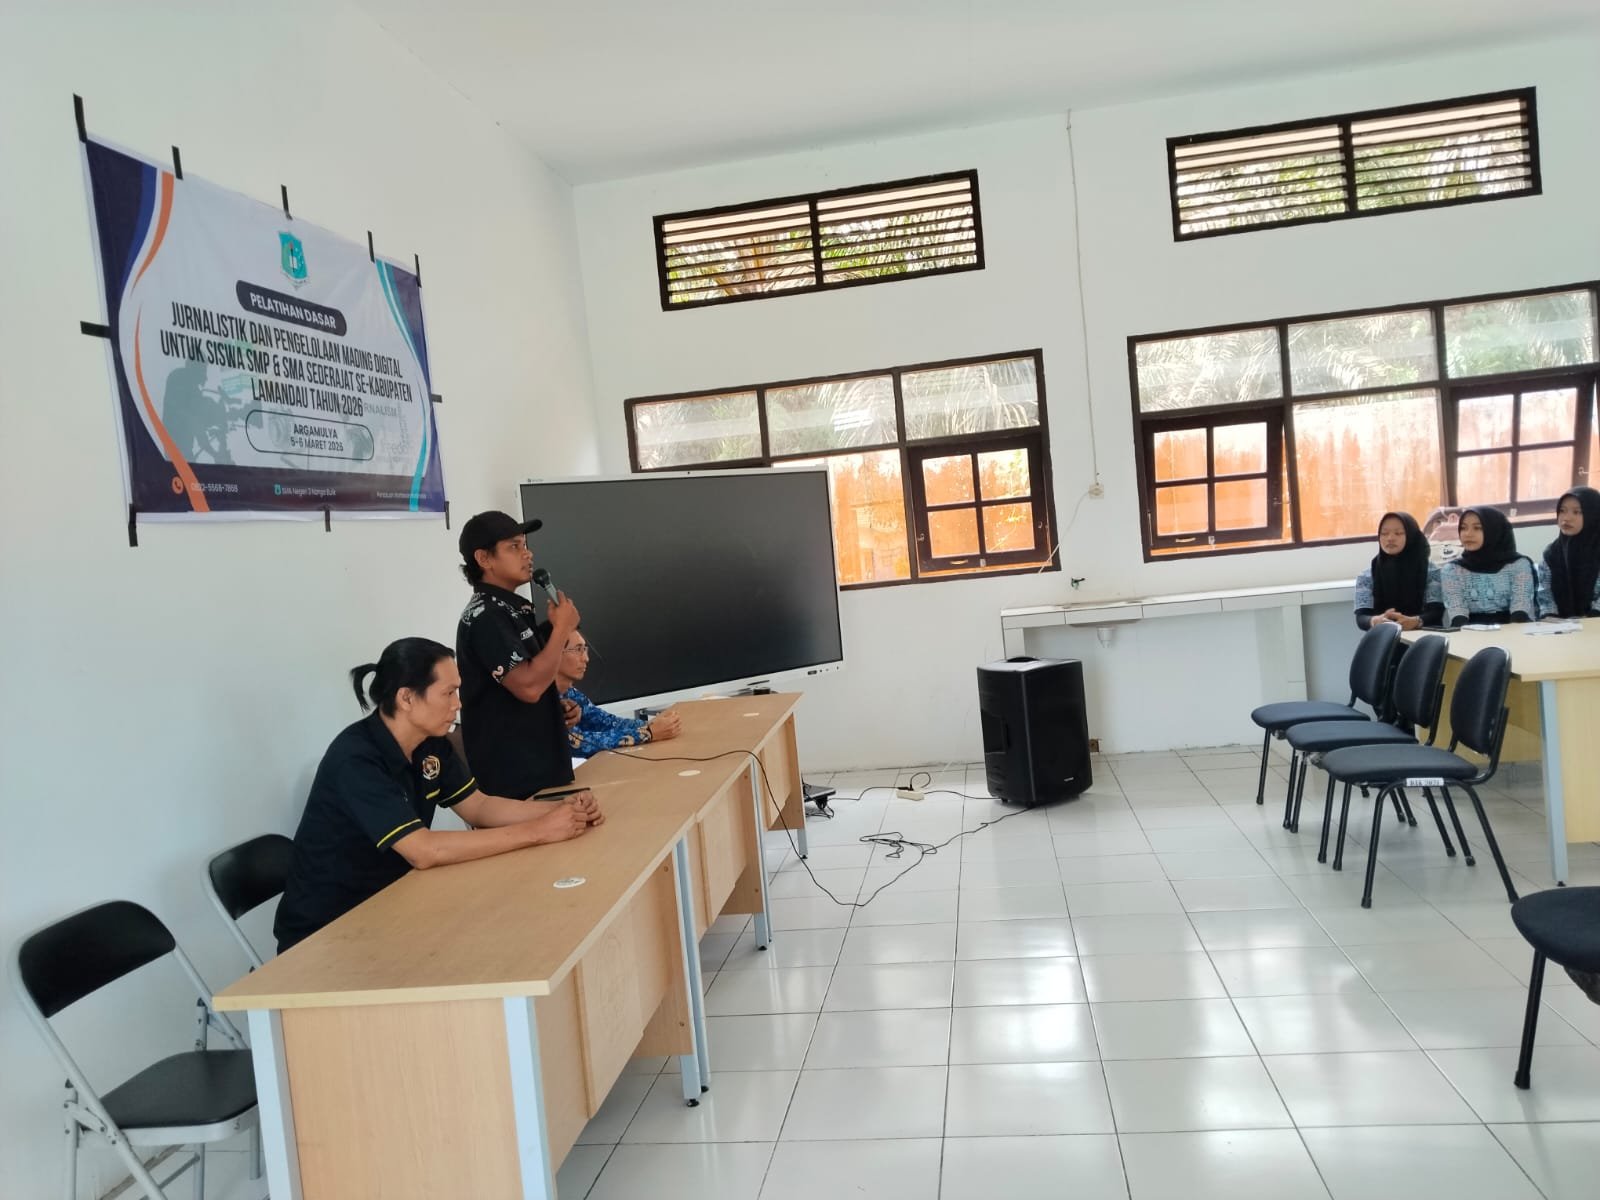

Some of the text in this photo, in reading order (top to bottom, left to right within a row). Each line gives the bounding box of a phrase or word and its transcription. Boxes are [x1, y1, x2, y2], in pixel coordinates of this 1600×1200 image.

[249, 292, 336, 330] PELATIHAN DASAR
[172, 301, 403, 378] JURNALISTIK DAN PENGELOLAAN MADING DIGITAL
[160, 329, 413, 403] UNTUK SISWA SMP & SMA SEDERAJAT SE-KABUPATEN
[251, 378, 364, 417] LAMANDAU TAHUN 2026
[293, 423, 338, 439] ARGAMULYA
[304, 438, 327, 450] MARET
